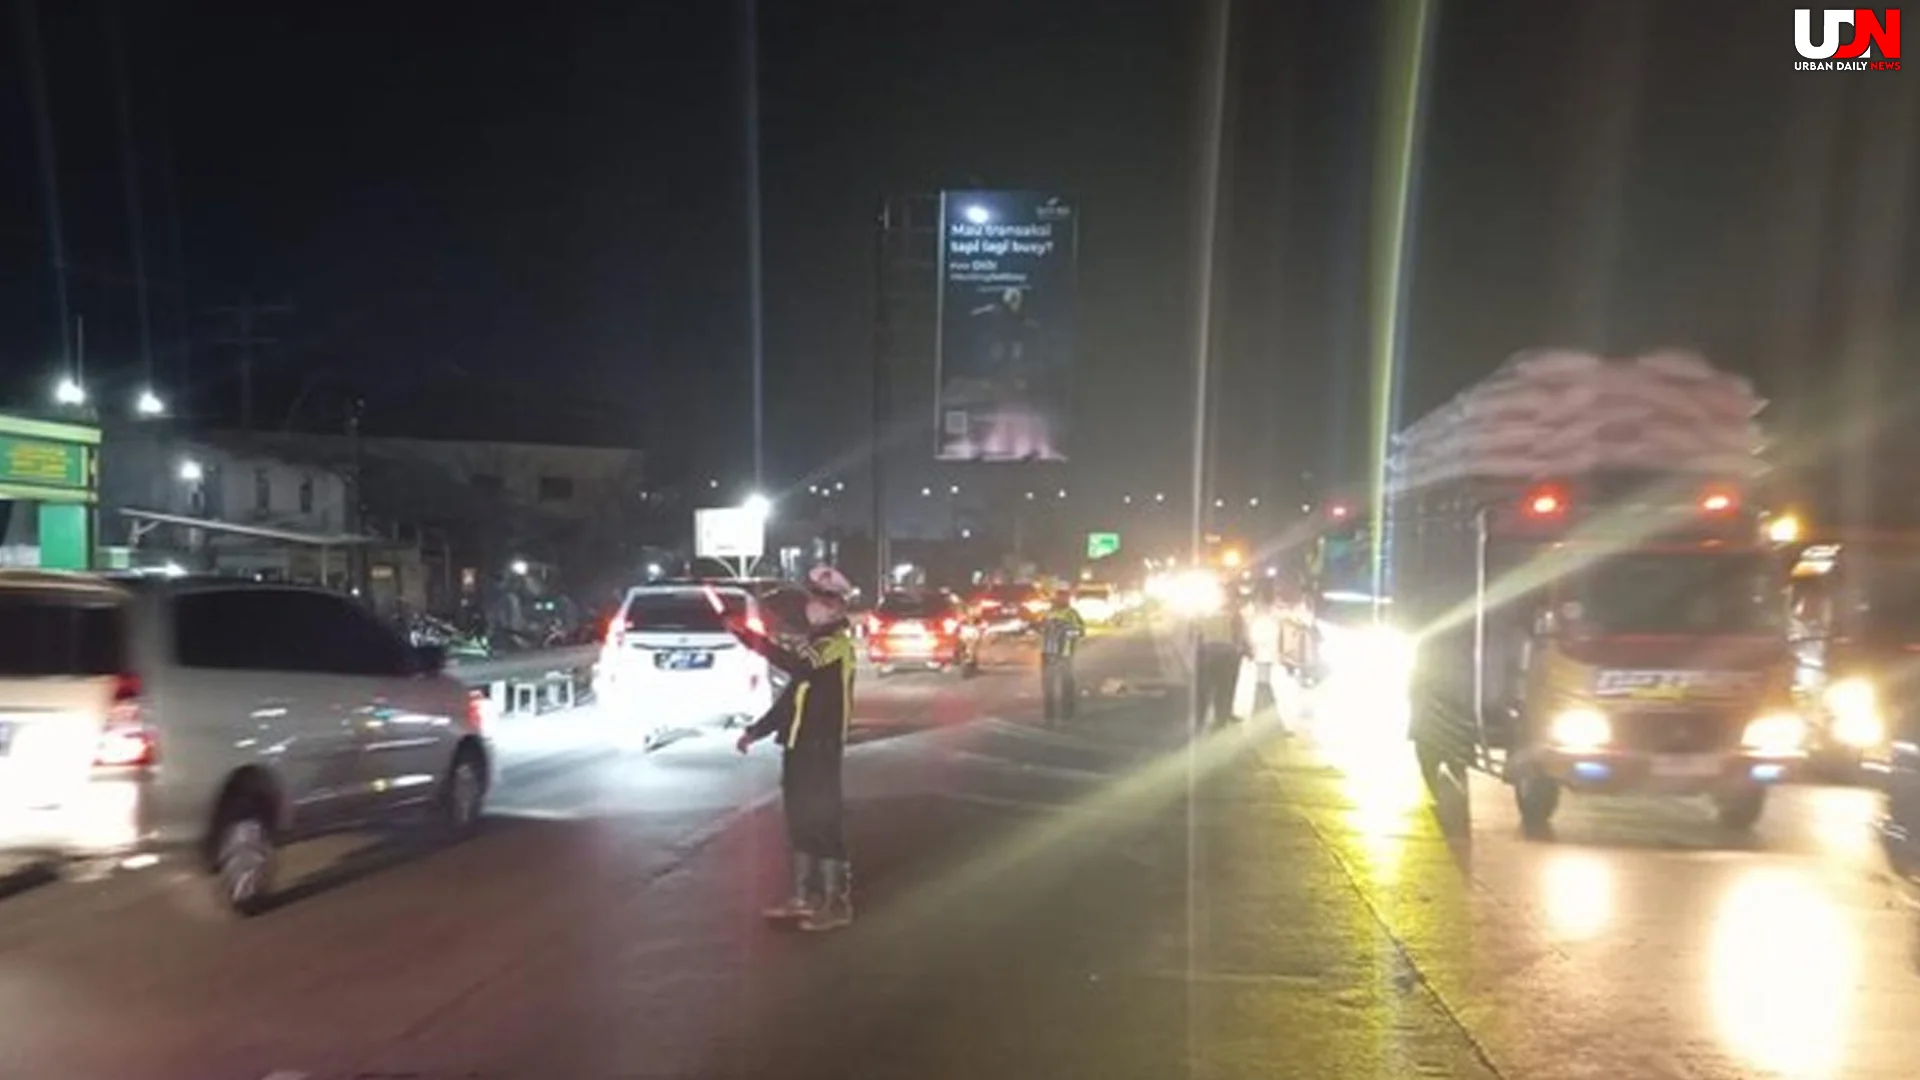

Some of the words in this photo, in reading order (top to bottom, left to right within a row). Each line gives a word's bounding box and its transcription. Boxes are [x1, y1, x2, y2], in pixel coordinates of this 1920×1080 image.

[984, 222, 1051, 237] transaksi
[950, 239, 979, 254] tapi
[981, 239, 1008, 255] lagi
[1012, 240, 1053, 257] busy?
